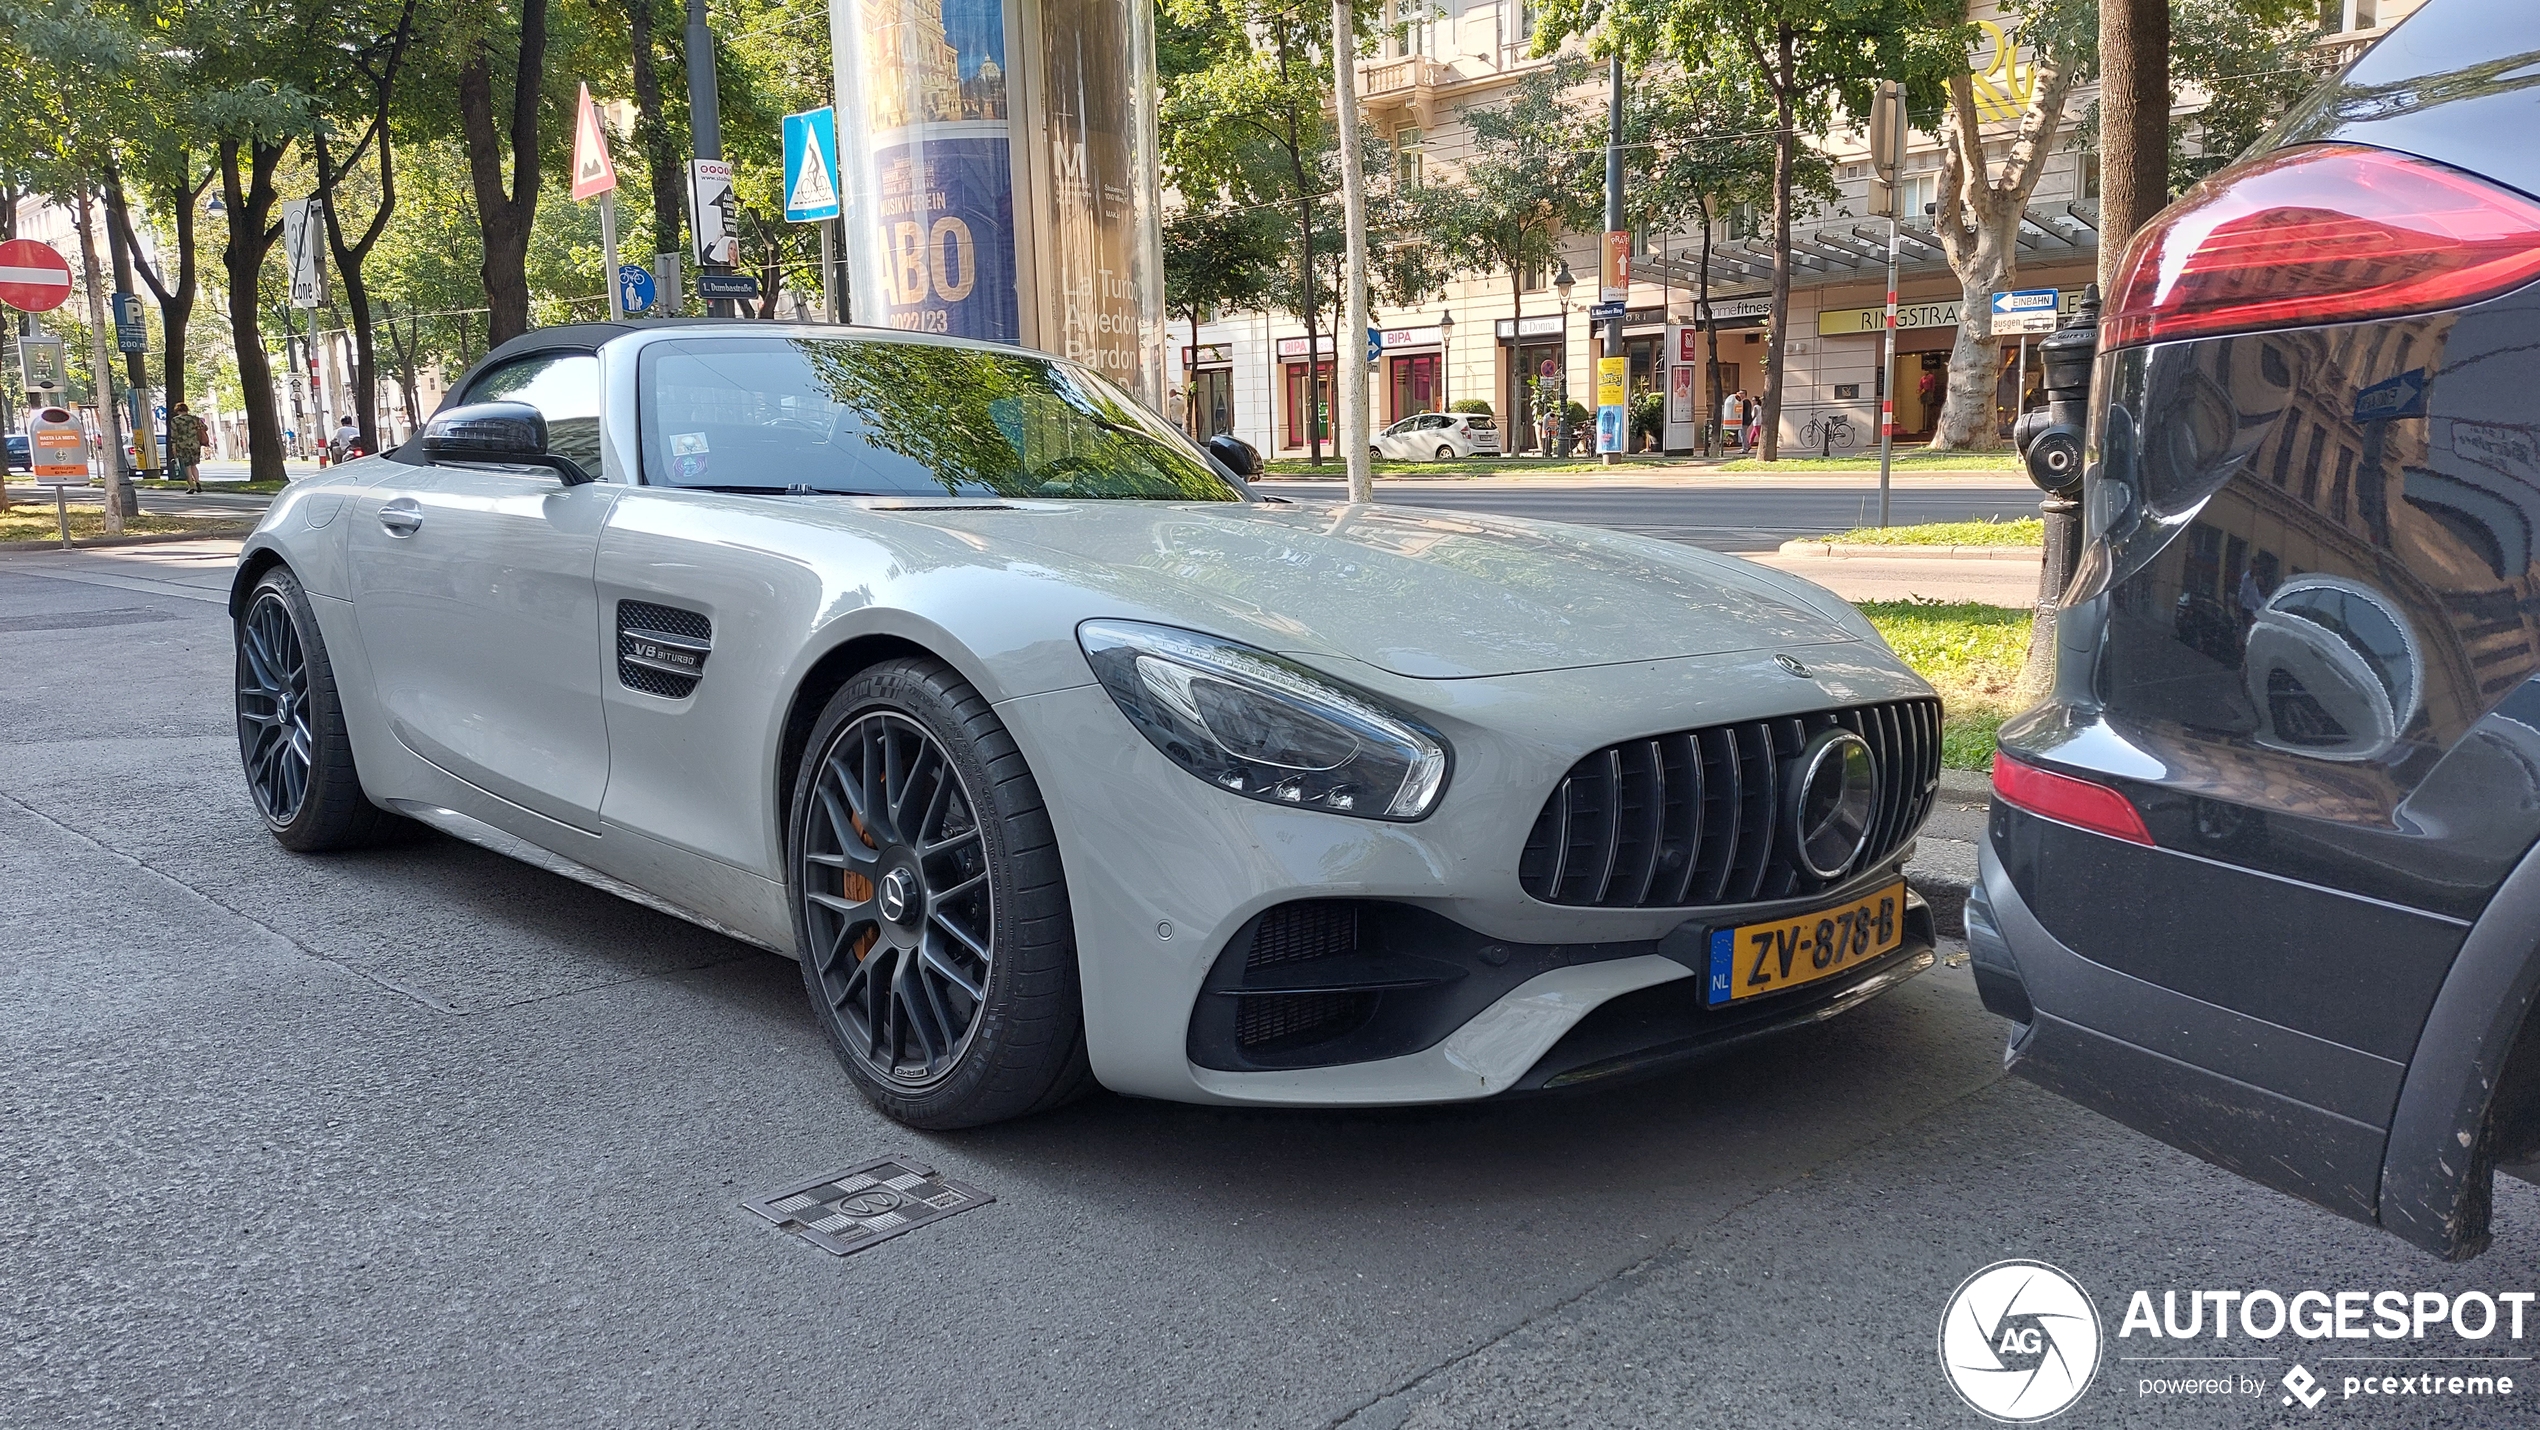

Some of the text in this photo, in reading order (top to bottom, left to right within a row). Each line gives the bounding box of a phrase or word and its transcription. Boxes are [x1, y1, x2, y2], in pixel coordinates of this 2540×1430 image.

[879, 192, 947, 217] MUSIKVEREIN
[877, 216, 975, 306] ABO
[711, 283, 752, 292] Dumbastraße
[2012, 295, 2050, 307] EINBAHN
[1529, 321, 1555, 333] Donna
[1993, 317, 2023, 330] ausgen.
[1387, 331, 1411, 344] BIPA
[1284, 340, 1307, 354] BIPA
[634, 642, 695, 665] V8 BITURBO
[1747, 896, 1895, 987] ZV-878-B
[1712, 973, 1729, 991] NL
